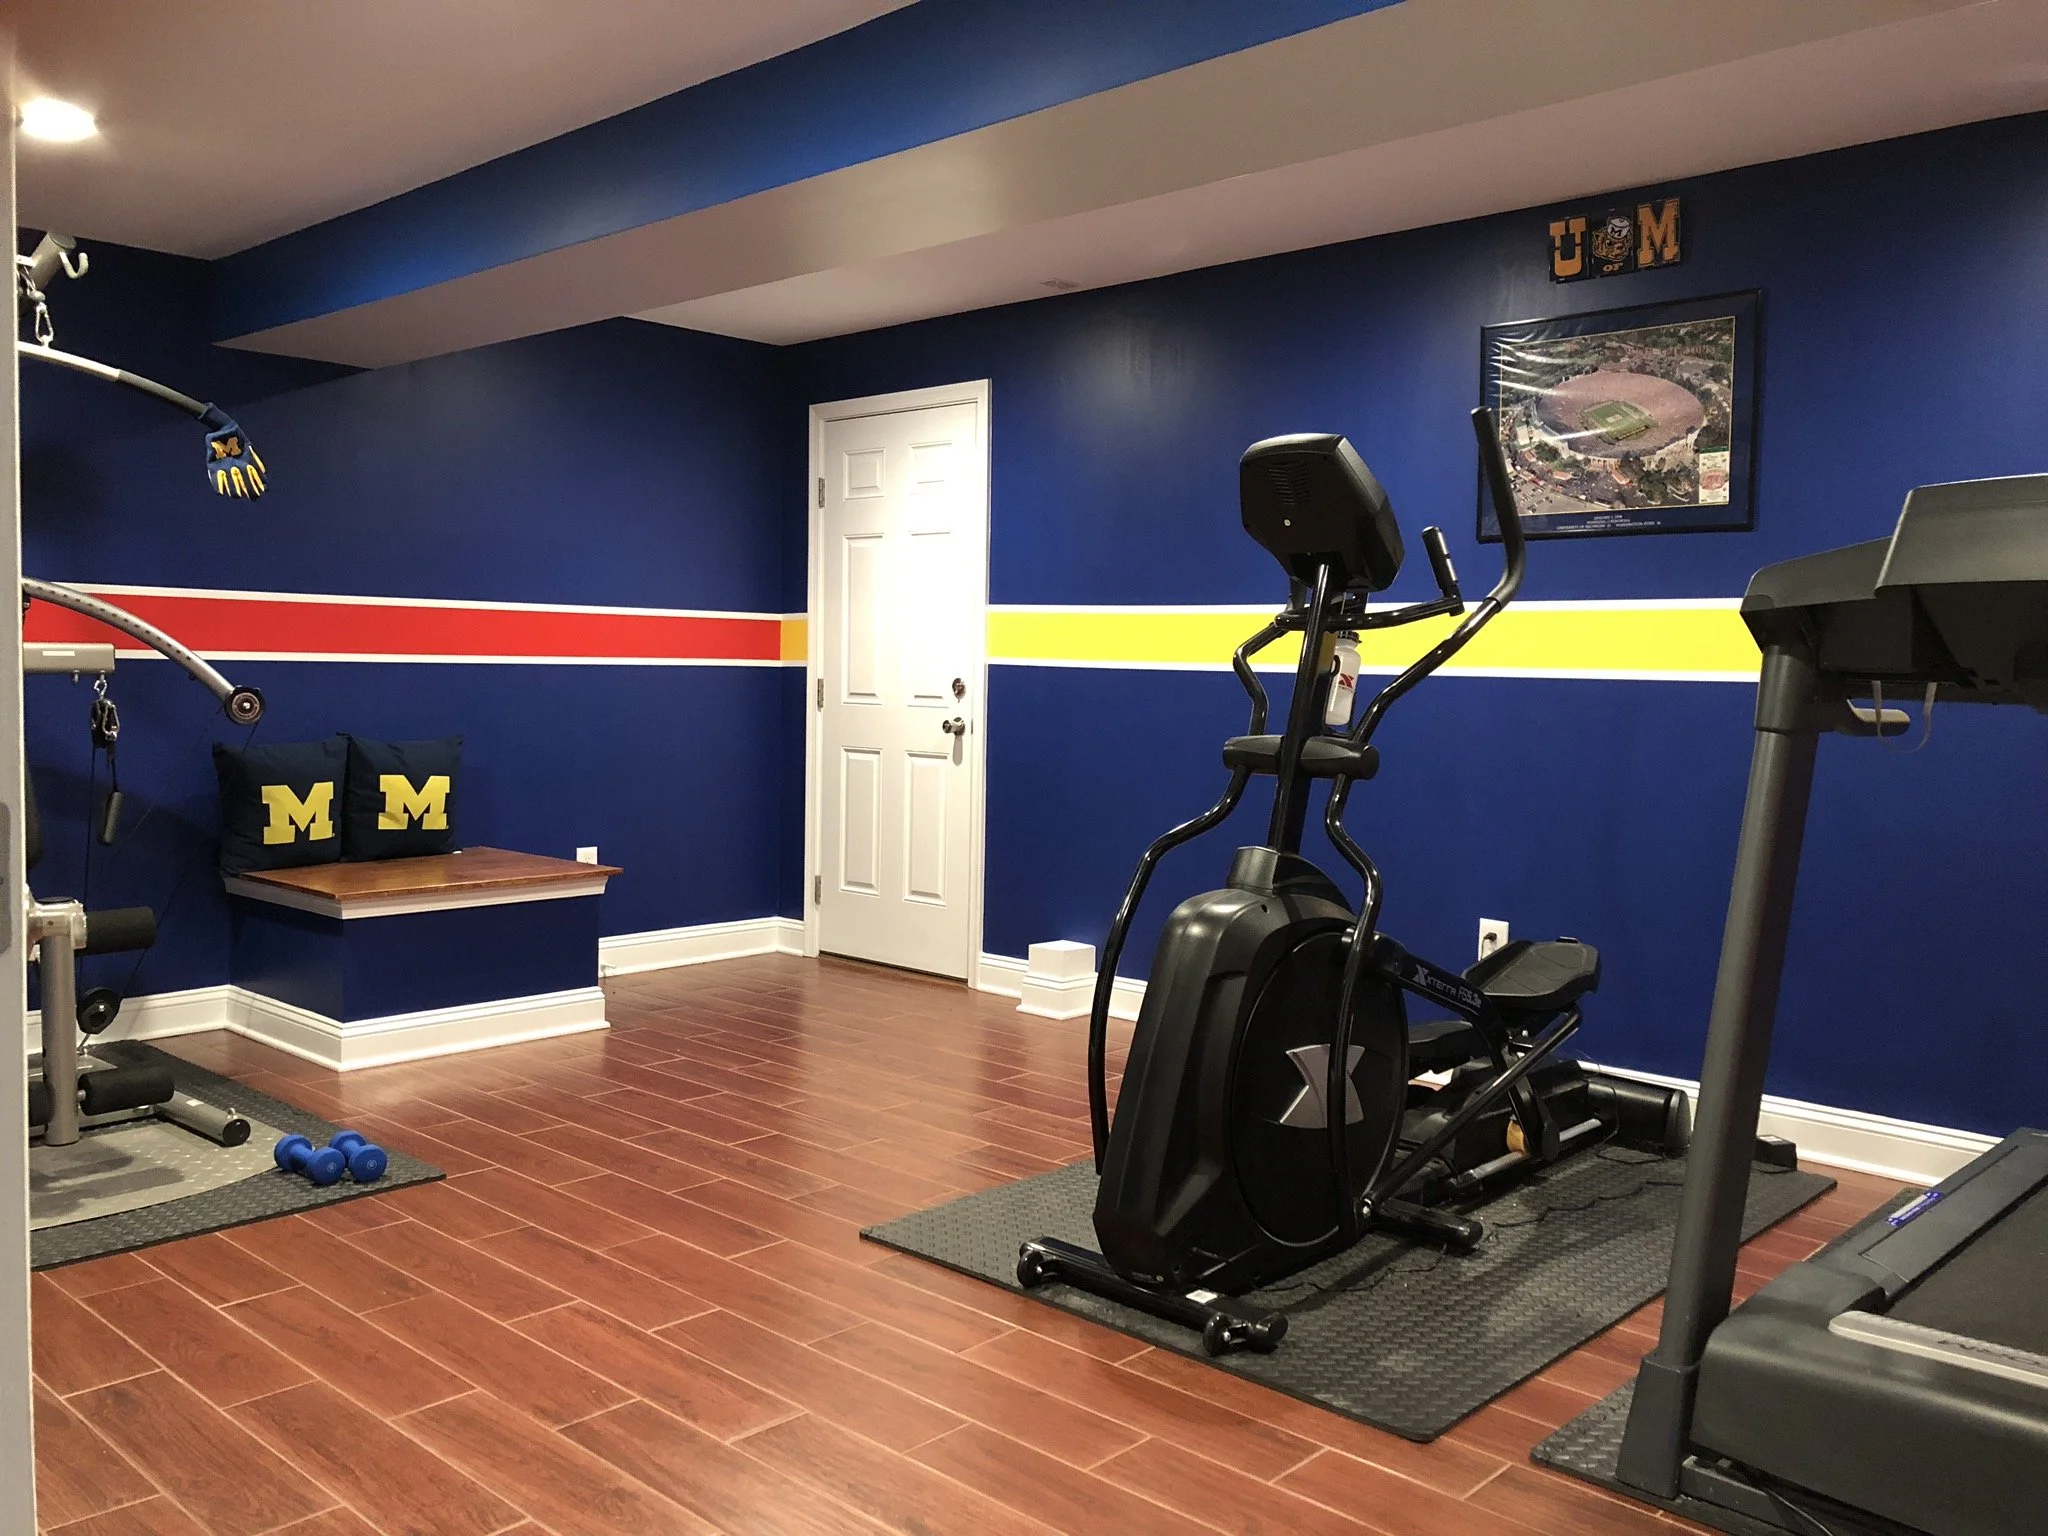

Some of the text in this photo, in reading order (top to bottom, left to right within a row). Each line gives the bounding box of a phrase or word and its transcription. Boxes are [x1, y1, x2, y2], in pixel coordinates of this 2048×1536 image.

[1549, 217, 1586, 277] U
[1637, 199, 1680, 268] M
[211, 436, 242, 459] M
[261, 781, 335, 845] M
[378, 774, 451, 830] M
